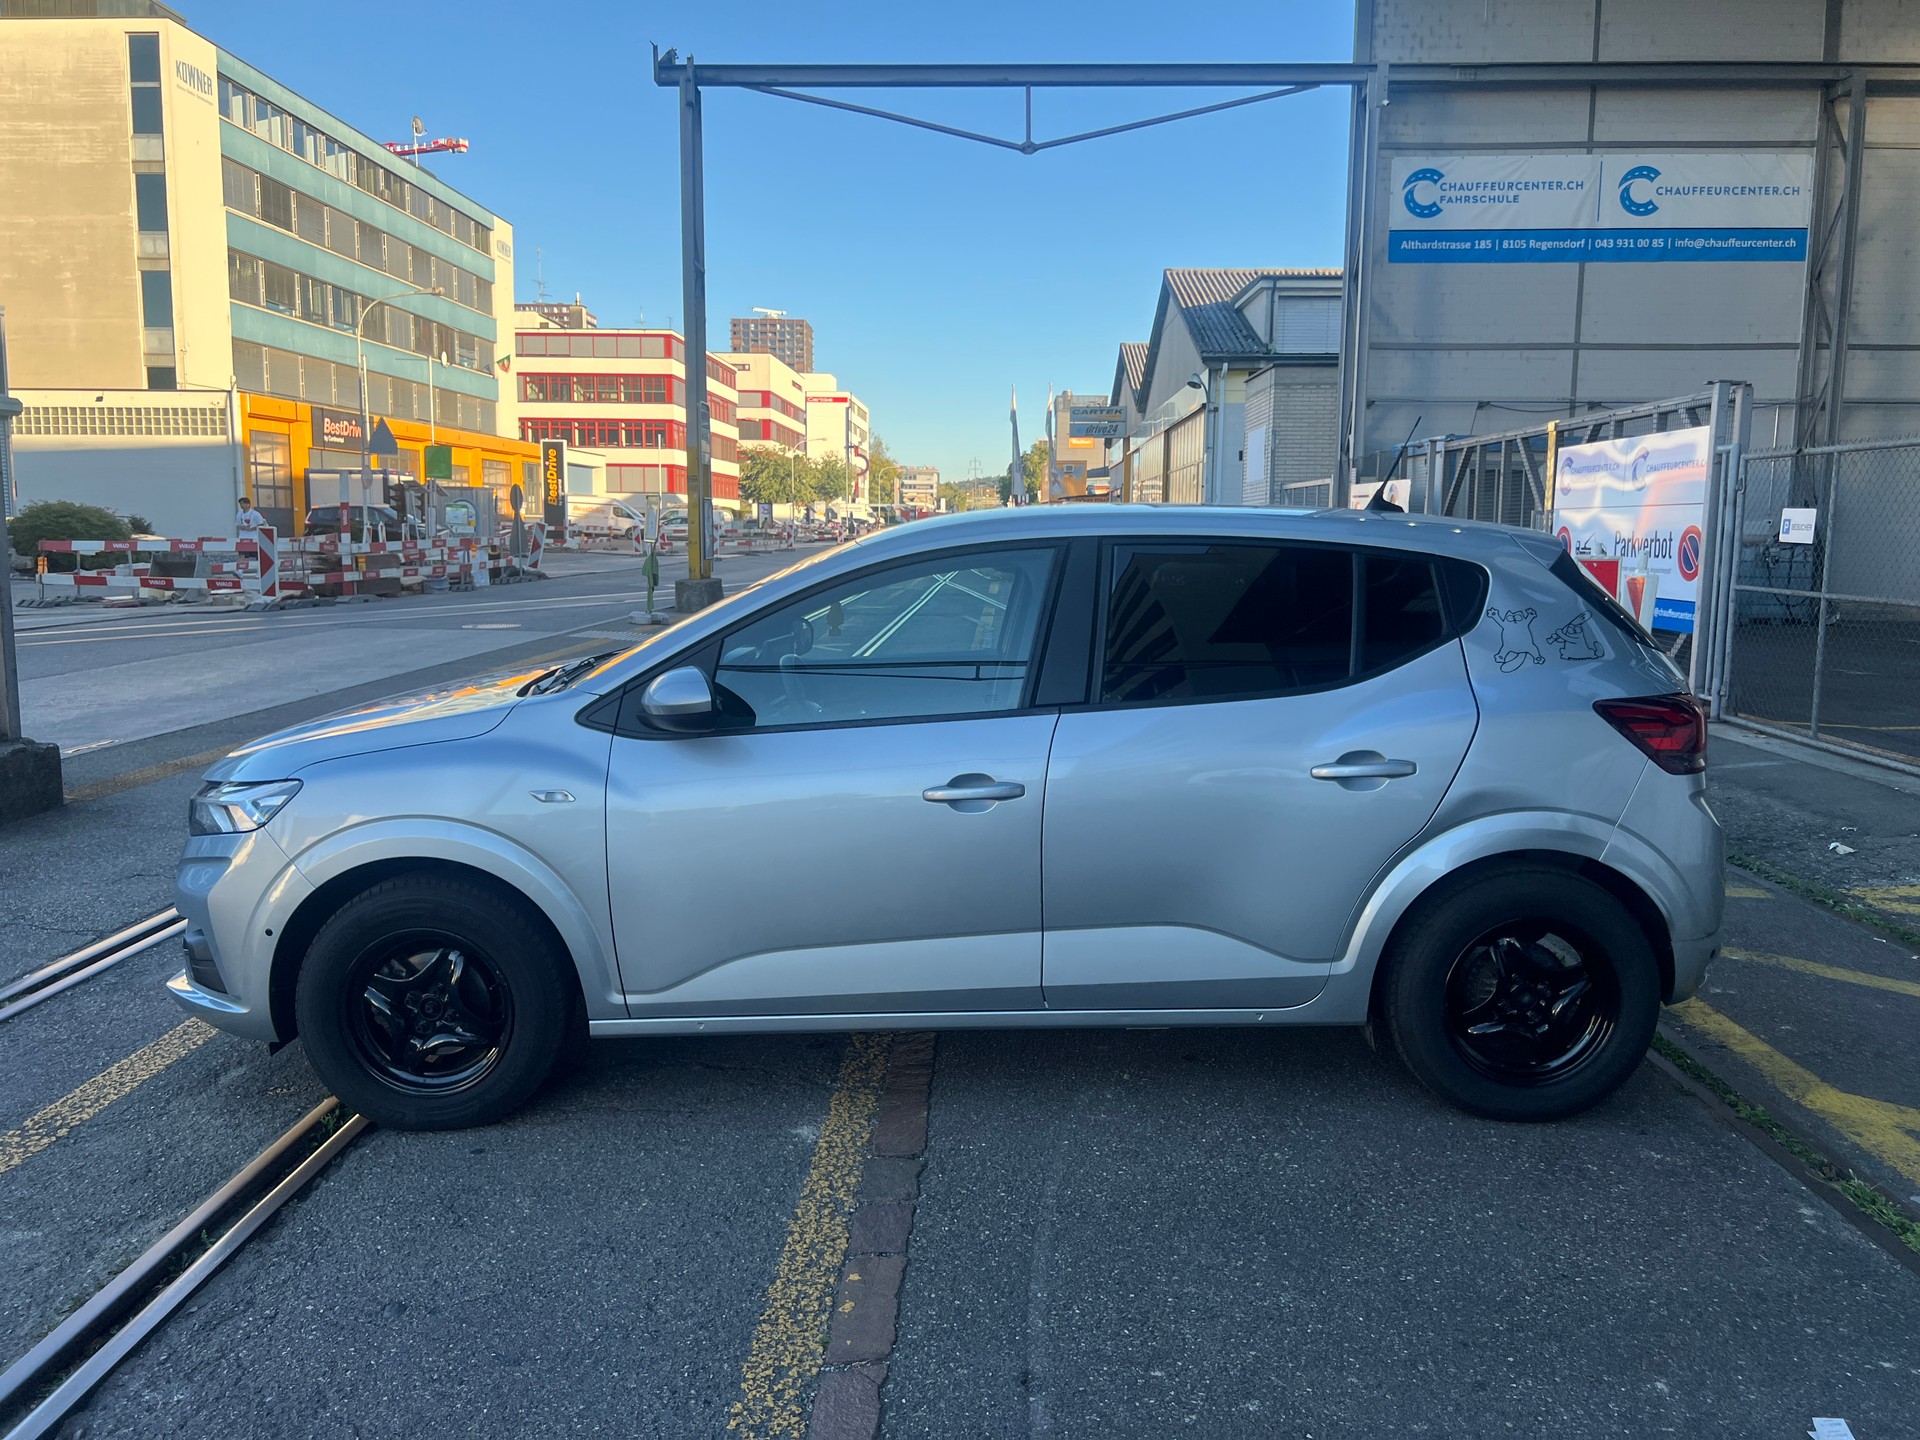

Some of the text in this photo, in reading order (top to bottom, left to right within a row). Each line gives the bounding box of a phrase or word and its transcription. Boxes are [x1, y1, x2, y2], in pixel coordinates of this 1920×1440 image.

[176, 60, 213, 96] KOWNER
[1439, 181, 1584, 192] CHAUFFEURCENTER.CH
[1655, 186, 1800, 196] CHAUFFEURCENTER.CH
[1439, 194, 1520, 204] FAHRSCHULE
[1400, 237, 1796, 251] Althardstrasse 185 8105 Regensdorf 043 931 00 85 info@chauffeurcenter.ch
[1085, 424, 1119, 433] drive24
[546, 448, 558, 506] BestDrive
[1613, 530, 1674, 559] Parkverbot
